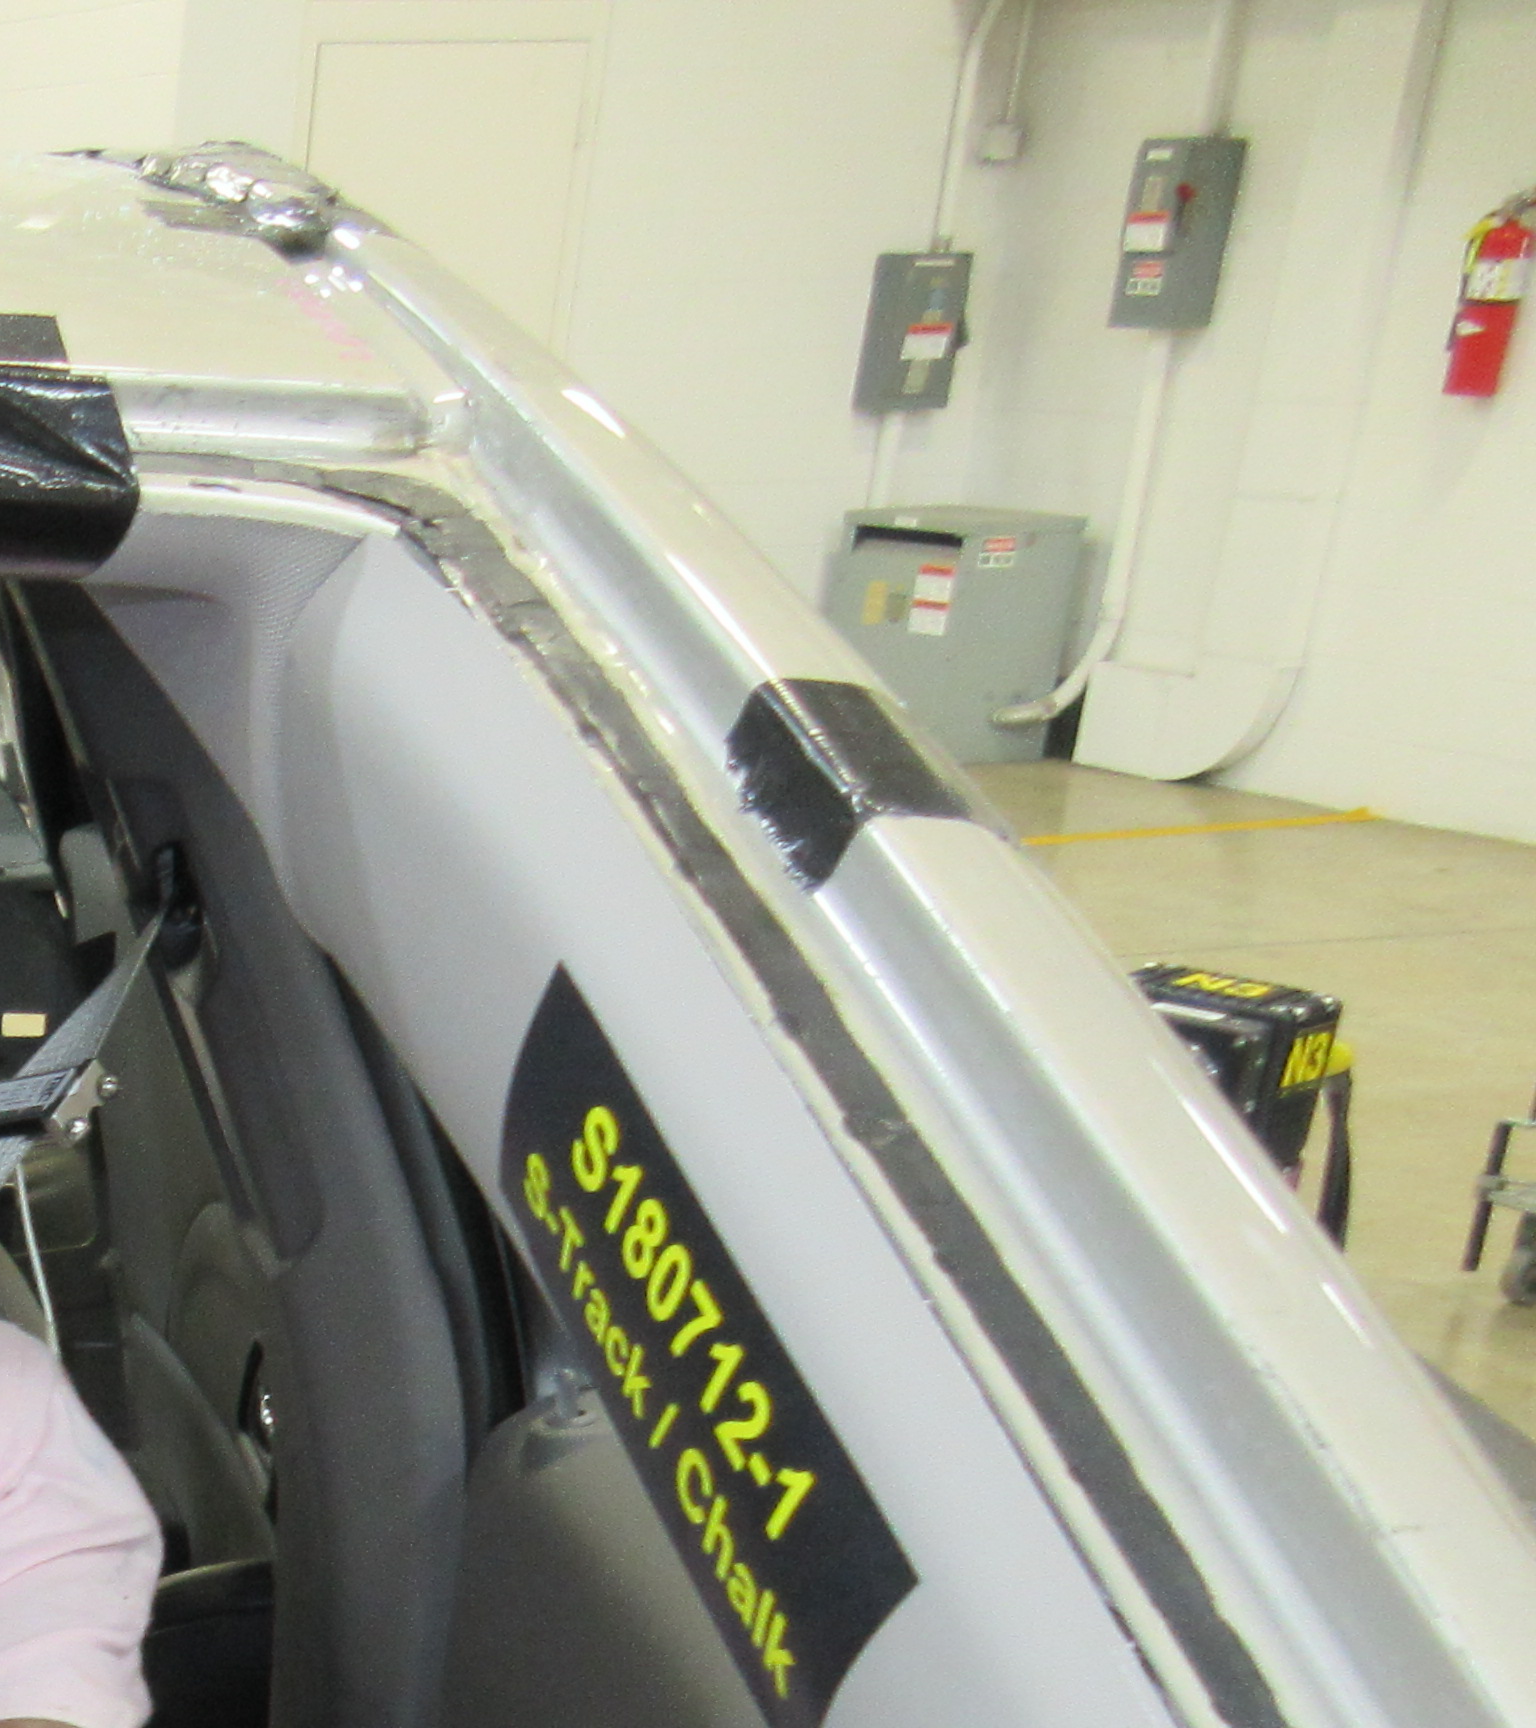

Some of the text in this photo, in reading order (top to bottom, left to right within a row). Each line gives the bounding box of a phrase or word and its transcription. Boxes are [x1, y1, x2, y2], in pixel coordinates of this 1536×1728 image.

[1279, 1031, 1333, 1088] N3
[524, 1152, 652, 1419] S-Track
[676, 1447, 795, 1698] Chalk
[571, 1105, 815, 1541] S180712-1
